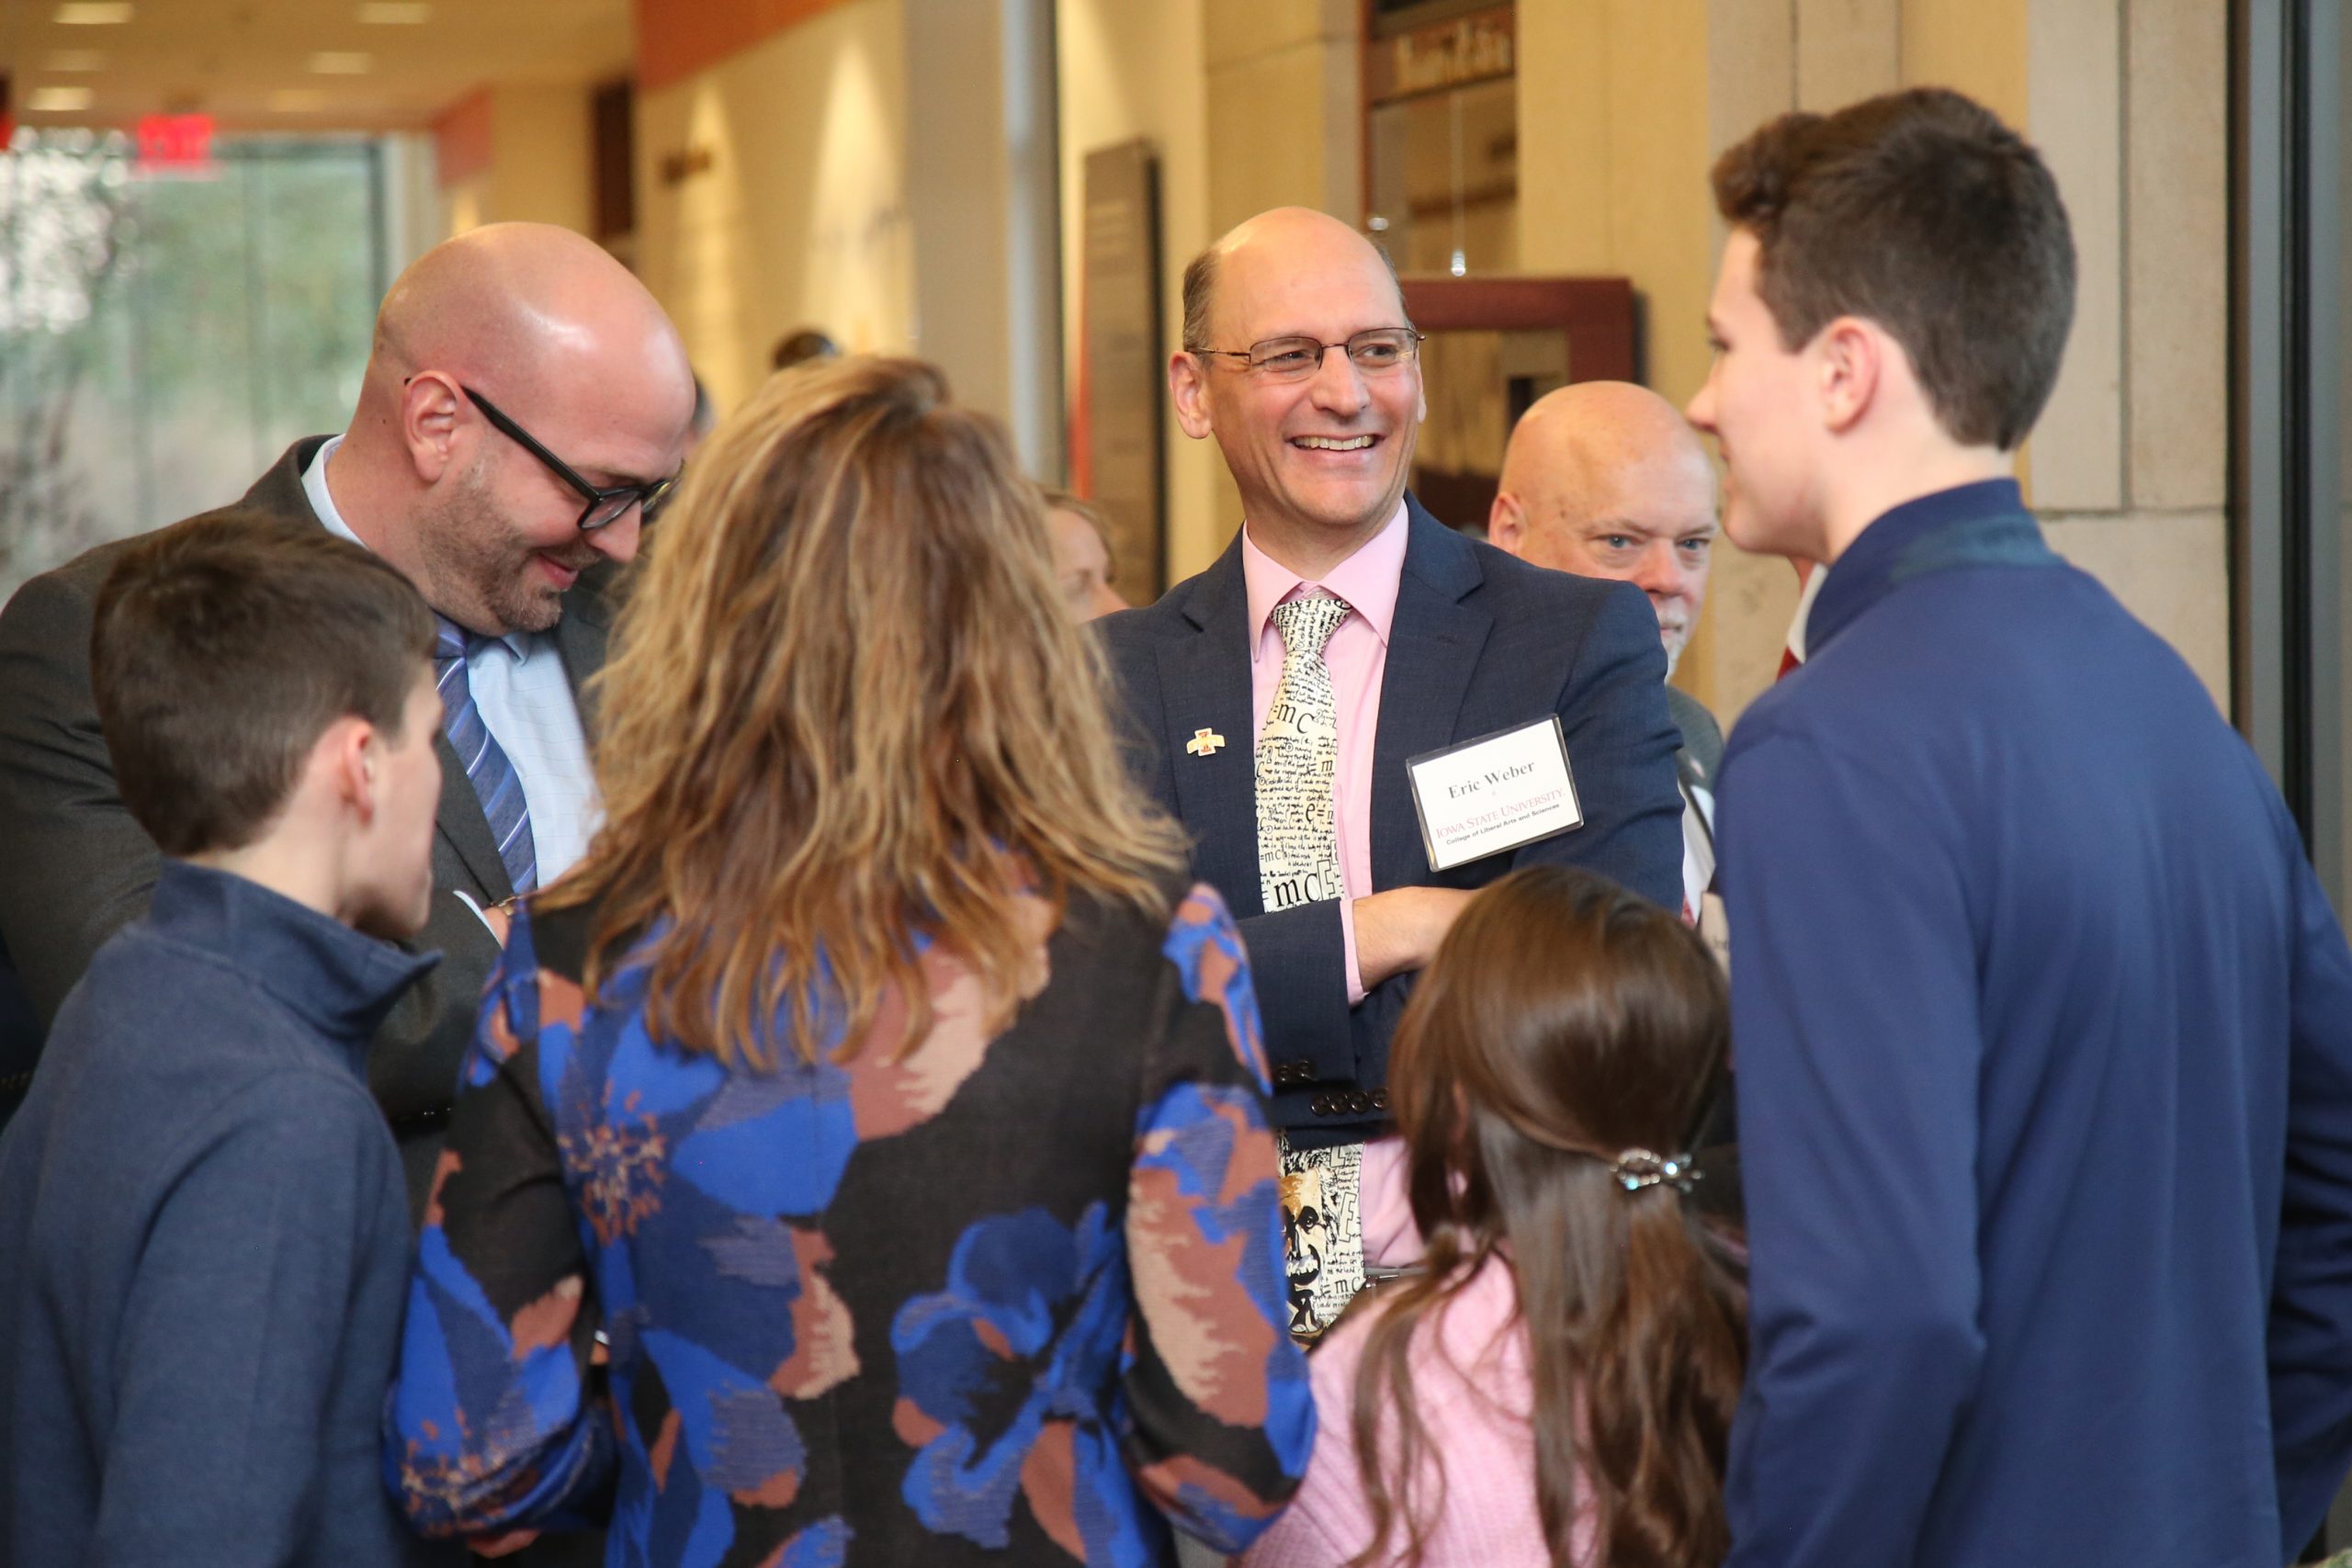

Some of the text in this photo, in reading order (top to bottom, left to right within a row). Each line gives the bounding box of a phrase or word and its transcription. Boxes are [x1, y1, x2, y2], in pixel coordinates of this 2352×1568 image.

[1448, 761, 1535, 799] Eric Weber
[1436, 822, 1465, 839] IOWA
[1466, 811, 1499, 829] STATE
[1446, 833, 1471, 845] College
[1480, 822, 1502, 834] Liberal
[1503, 818, 1517, 827] Arts
[1518, 813, 1531, 821] and
[1532, 803, 1560, 816] Sciences
